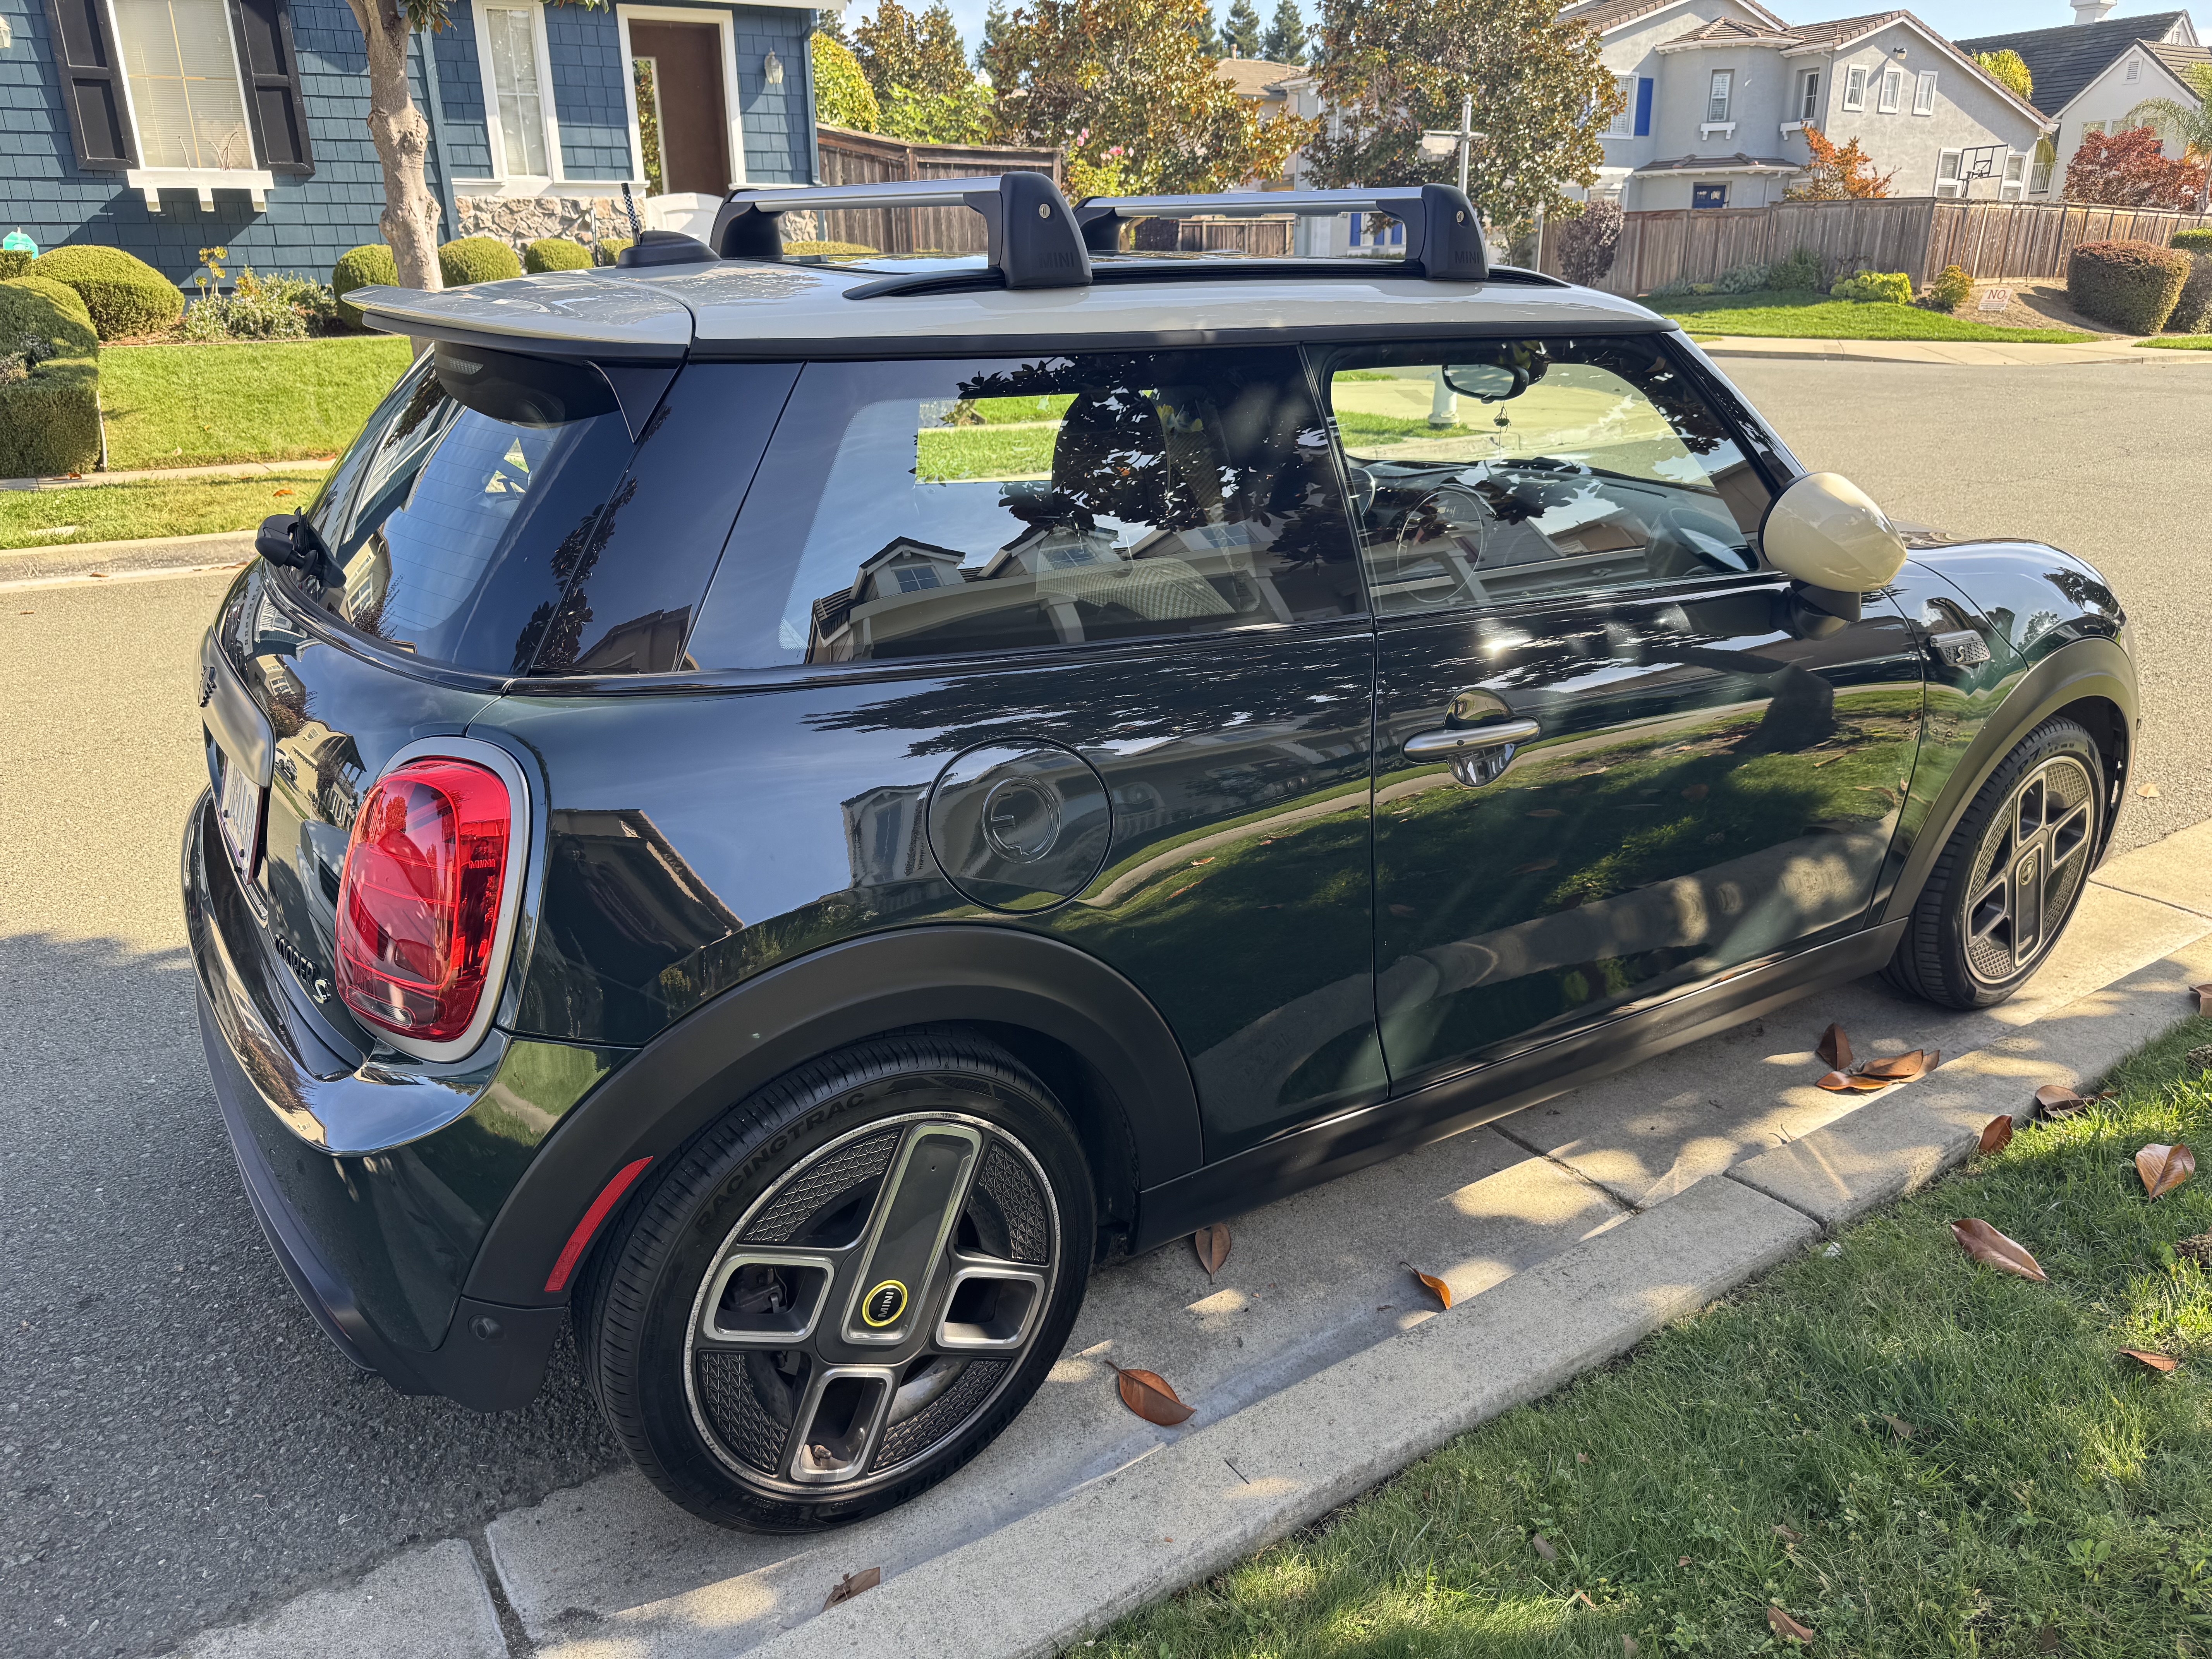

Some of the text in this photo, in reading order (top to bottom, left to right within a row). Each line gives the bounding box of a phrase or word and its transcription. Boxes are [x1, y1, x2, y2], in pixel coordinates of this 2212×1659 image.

[1038, 252, 1074, 268] MINI
[1455, 251, 1479, 264] MINI
[1987, 289, 2006, 299] NO
[1956, 645, 1965, 663] S
[1977, 747, 2041, 841] Cinturato P7
[469, 858, 495, 869] MINI
[275, 933, 331, 1004] COOPER S
[695, 1092, 865, 1235] RACINGTRAC
[878, 1292, 894, 1317] MINI
